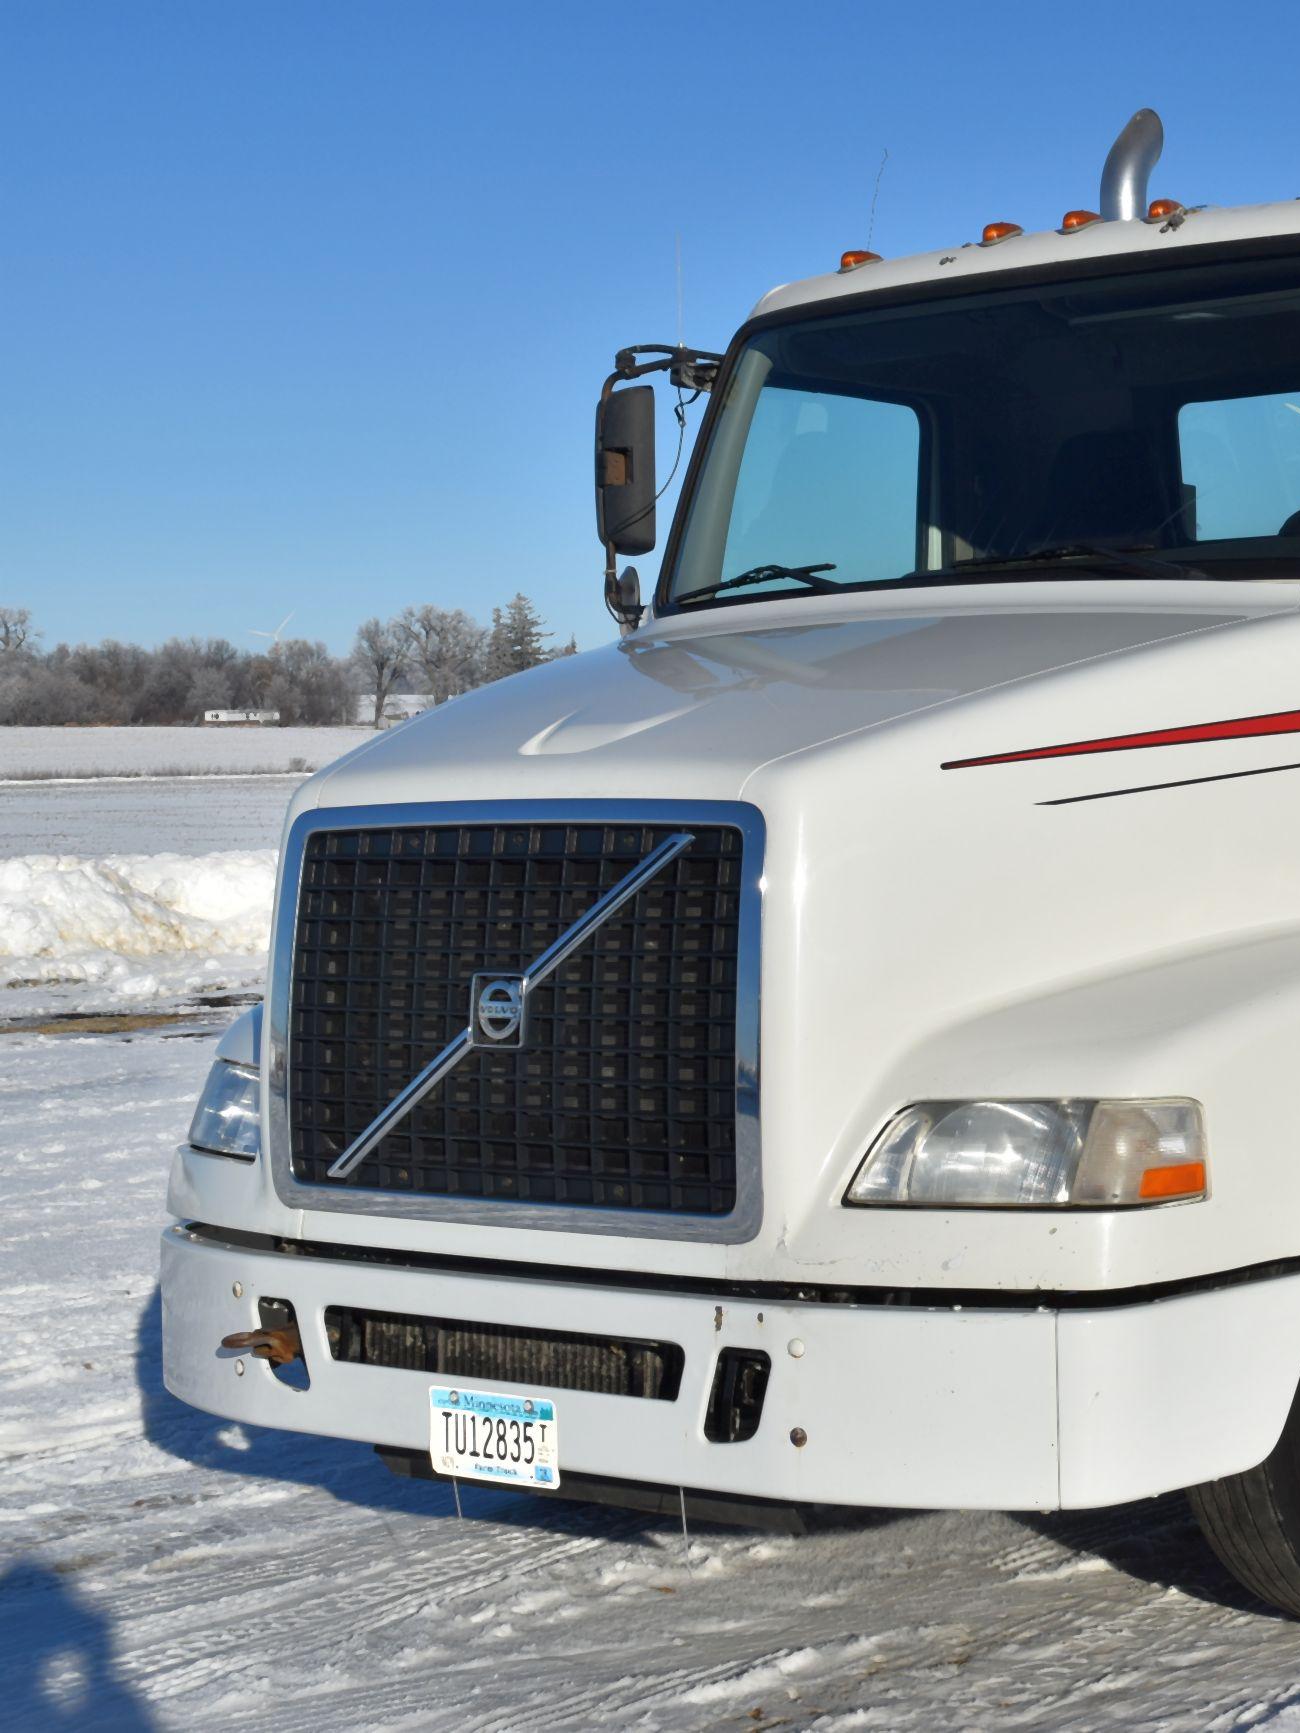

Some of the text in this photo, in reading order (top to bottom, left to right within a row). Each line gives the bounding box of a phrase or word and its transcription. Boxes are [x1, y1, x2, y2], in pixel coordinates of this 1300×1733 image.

[480, 1005, 518, 1014] VOLVO
[463, 1395, 521, 1412] Minnesota
[442, 1411, 535, 1464] TU12835
